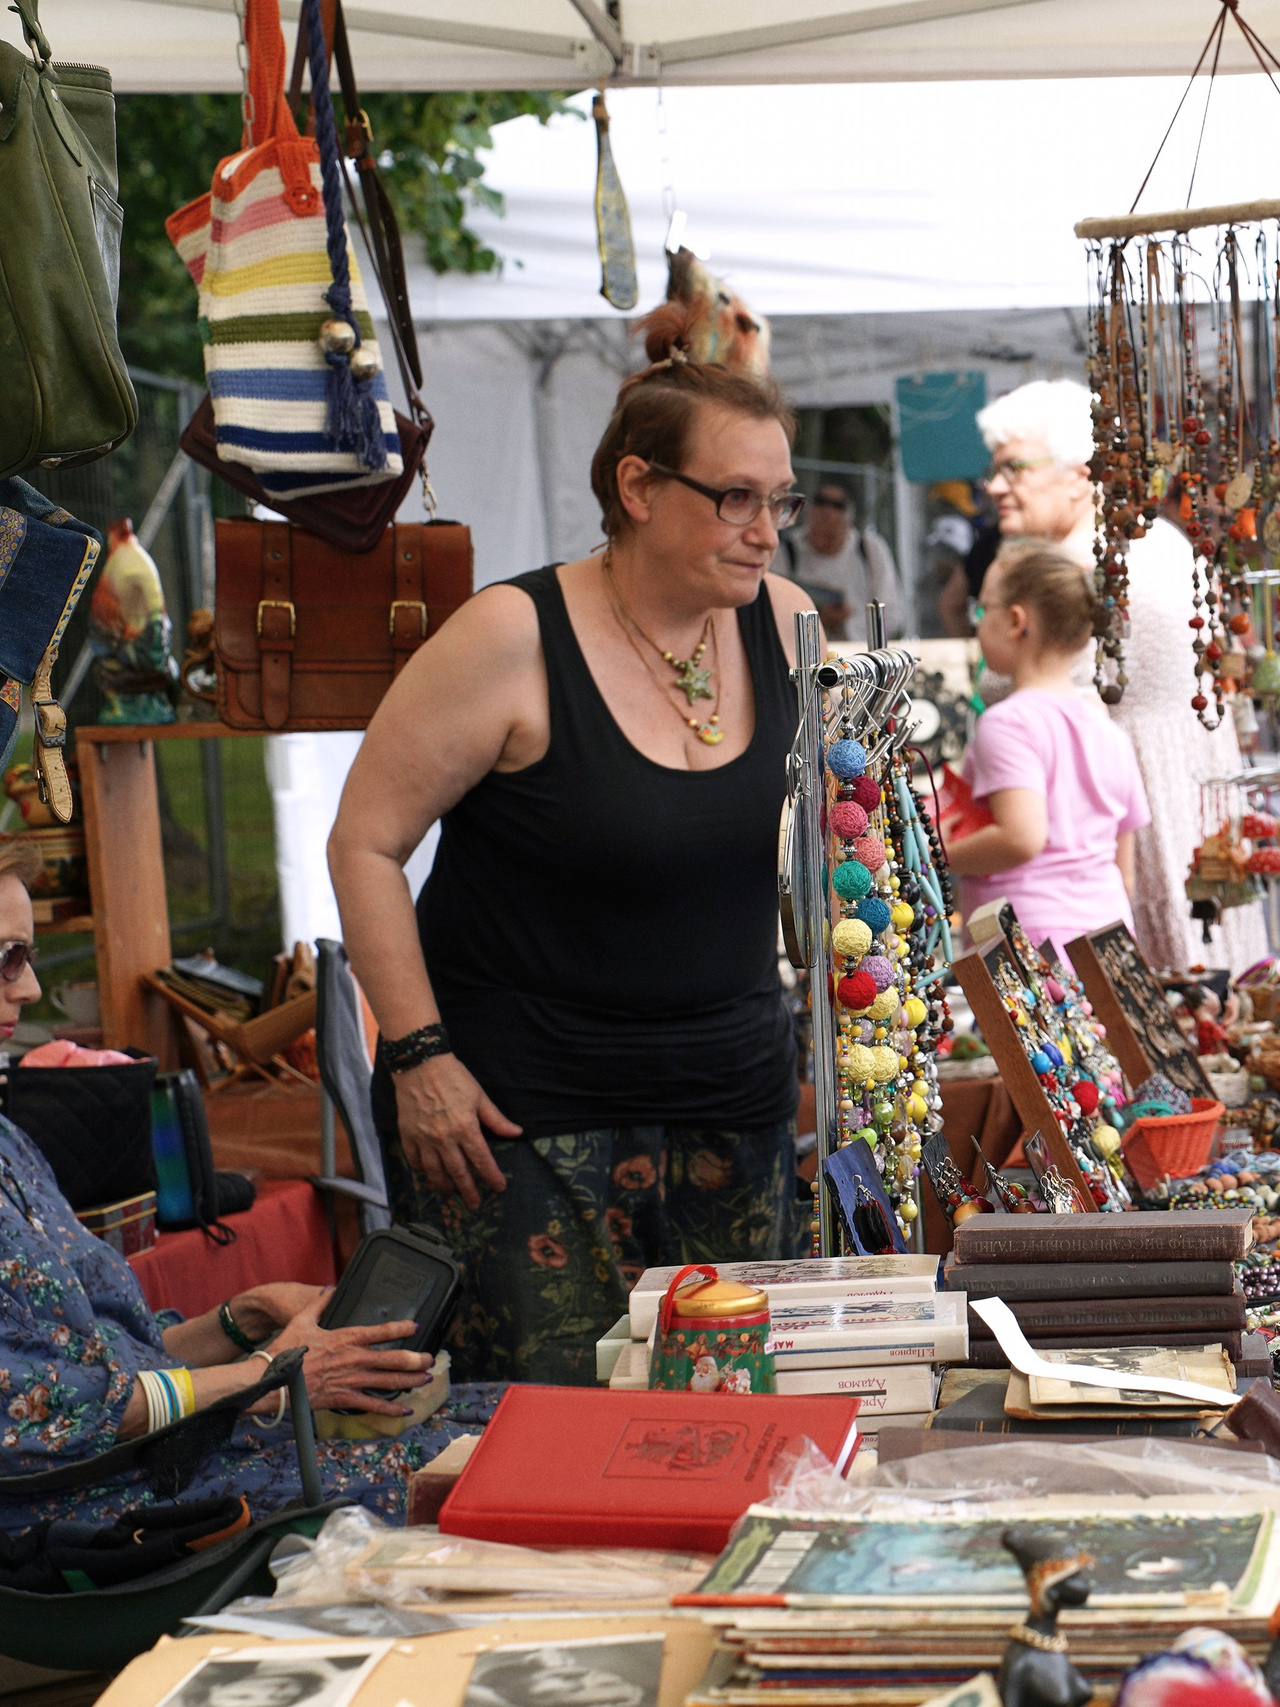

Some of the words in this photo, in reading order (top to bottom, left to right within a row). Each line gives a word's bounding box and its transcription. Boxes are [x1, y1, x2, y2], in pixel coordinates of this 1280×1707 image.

[772, 1340, 794, 1349] МАР
[889, 1347, 925, 1357] Парнов
[837, 1378, 887, 1390] Адамов
[860, 1395, 887, 1409] Арк
